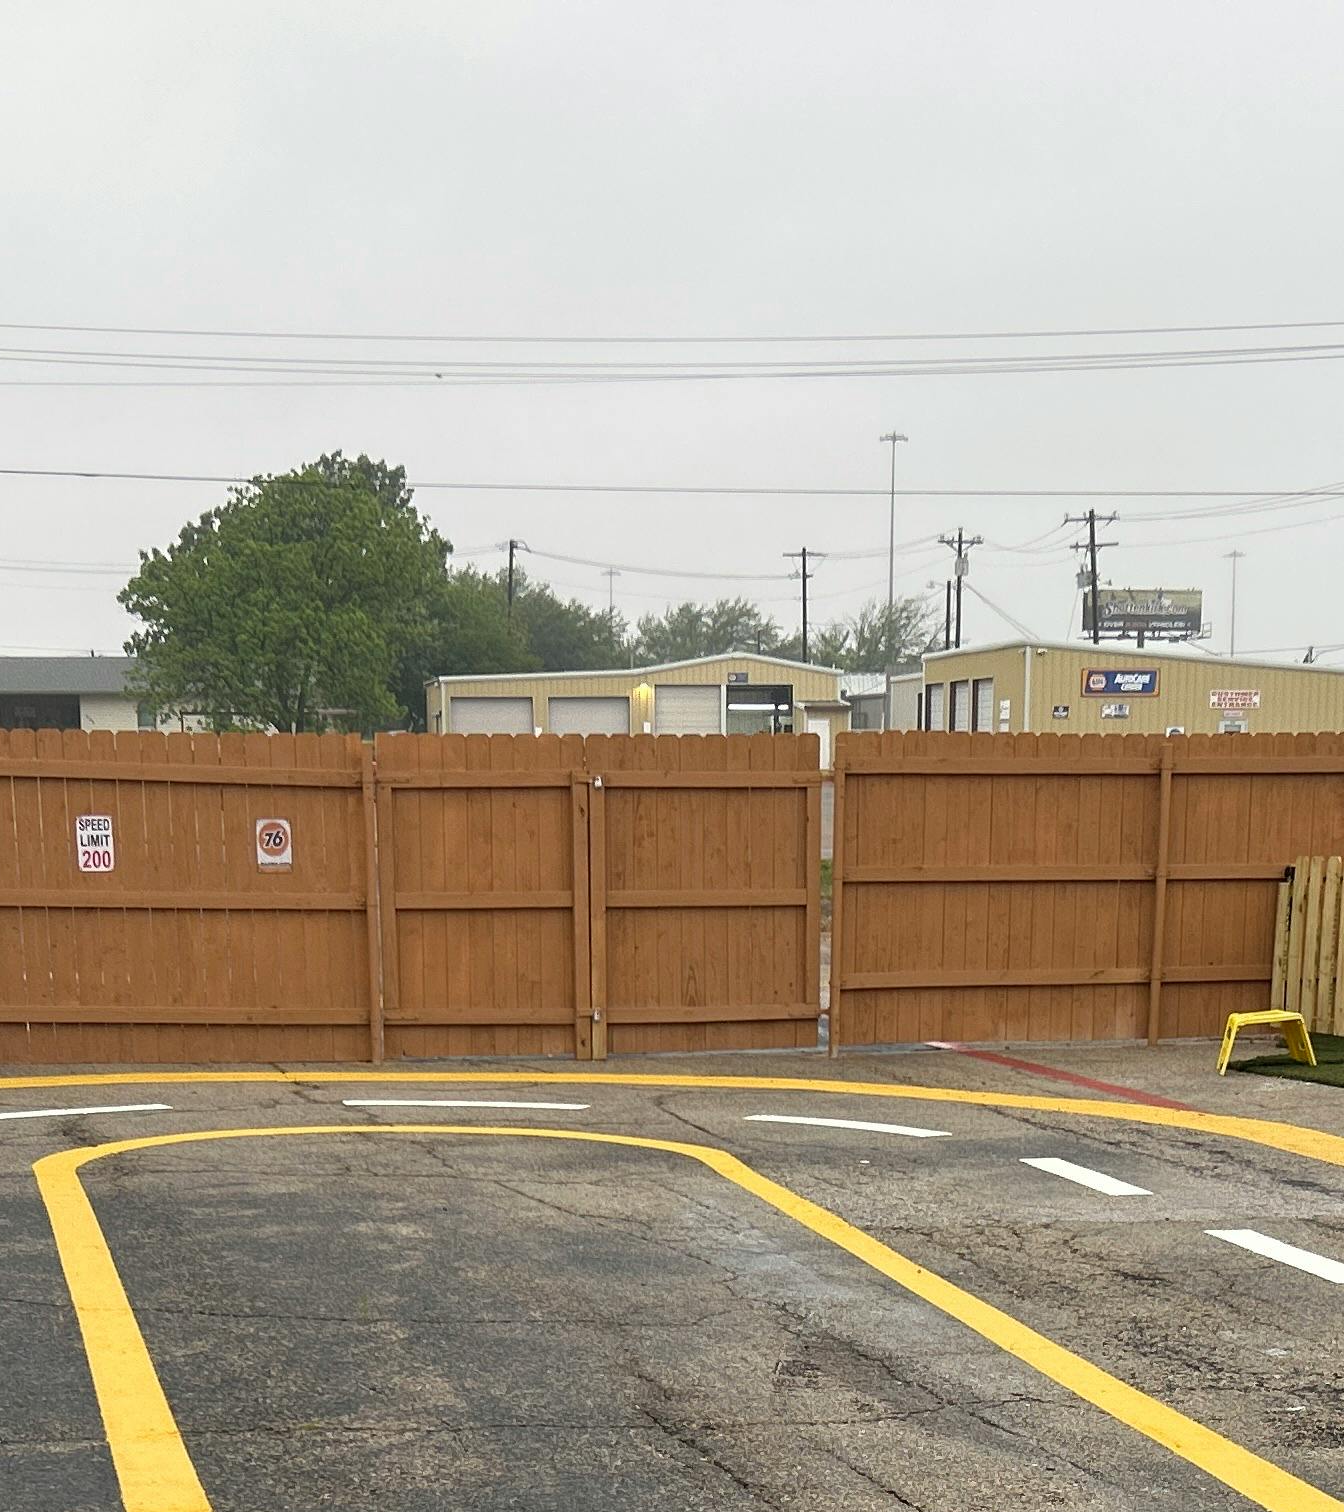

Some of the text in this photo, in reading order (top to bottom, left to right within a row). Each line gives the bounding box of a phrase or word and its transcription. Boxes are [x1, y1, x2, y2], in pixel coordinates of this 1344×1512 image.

[78, 818, 110, 831] SPEED
[80, 834, 110, 847] LIMIT
[264, 830, 284, 848] 76
[82, 850, 112, 868] 200
